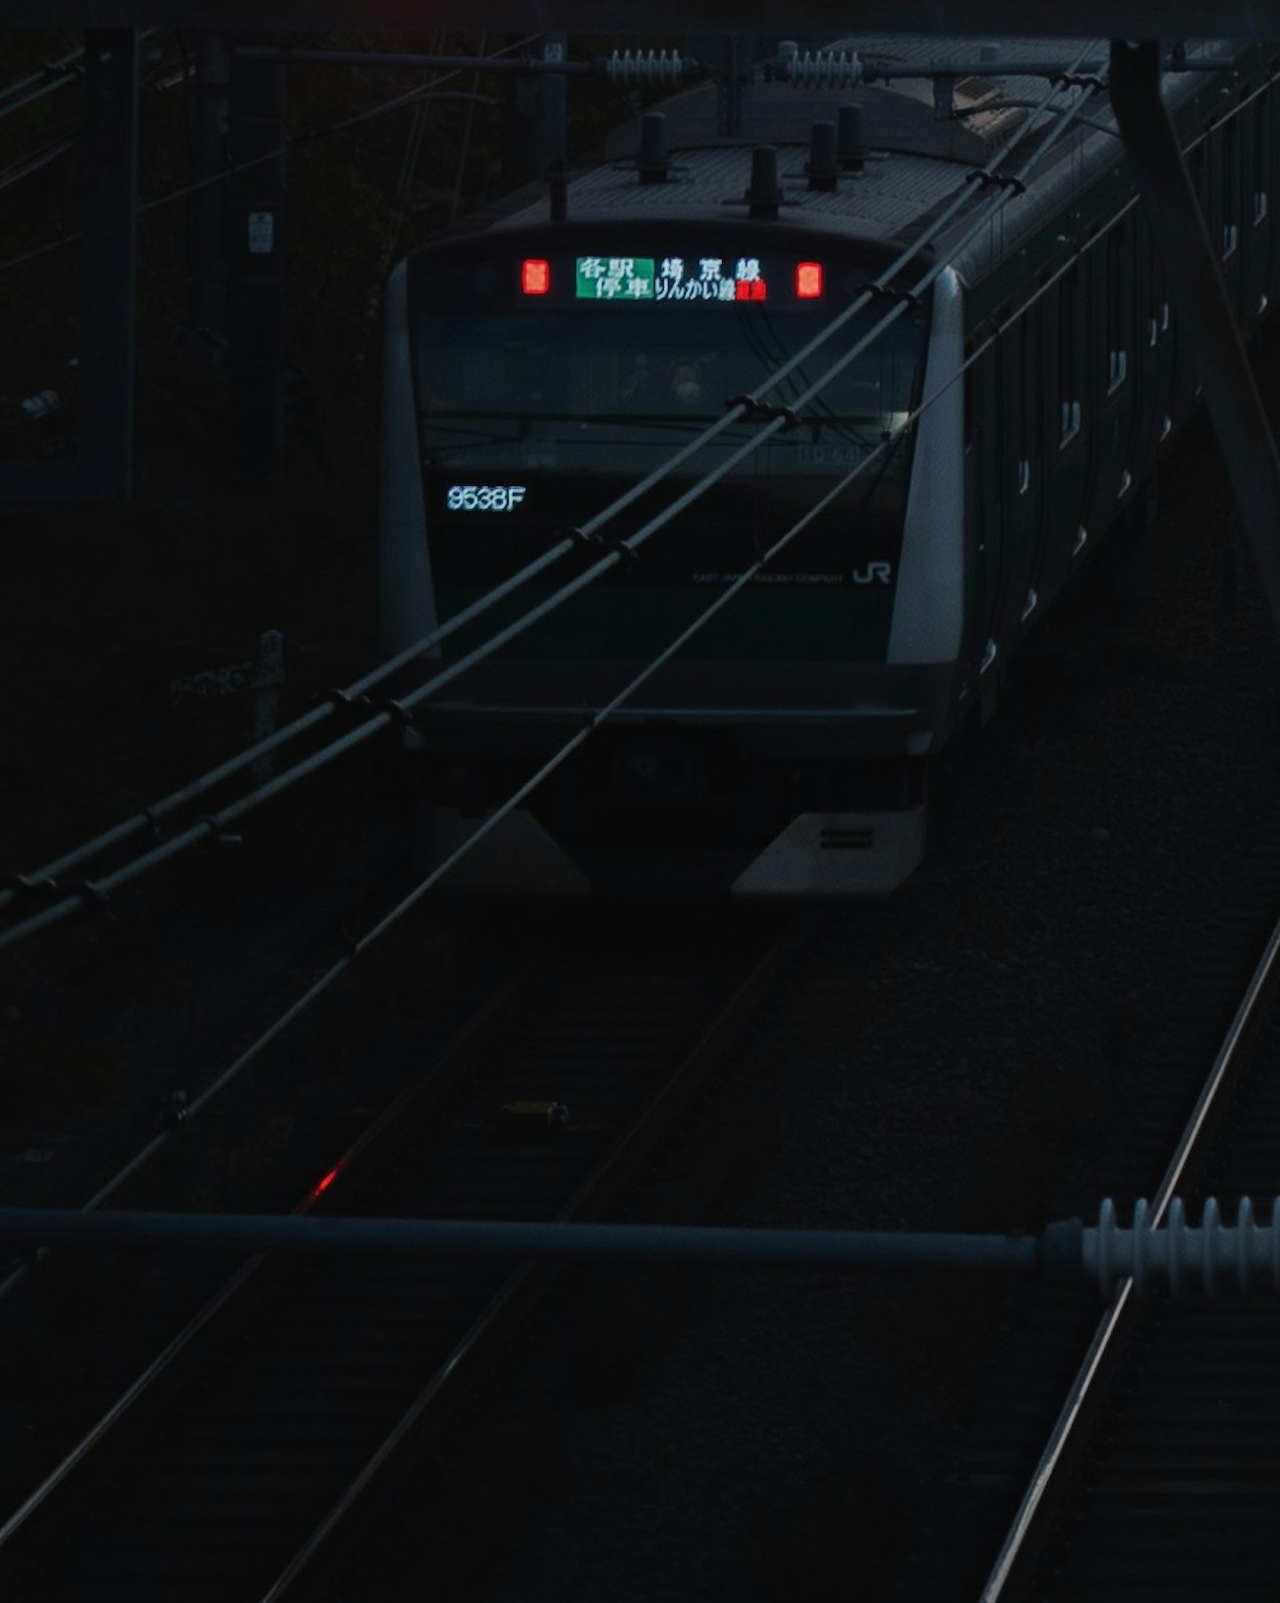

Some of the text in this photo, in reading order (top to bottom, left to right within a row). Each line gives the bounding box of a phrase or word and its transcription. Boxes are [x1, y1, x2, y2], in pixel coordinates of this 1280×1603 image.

[580, 257, 634, 279] 各駅
[596, 277, 652, 300] 停車
[853, 561, 892, 584] JR
